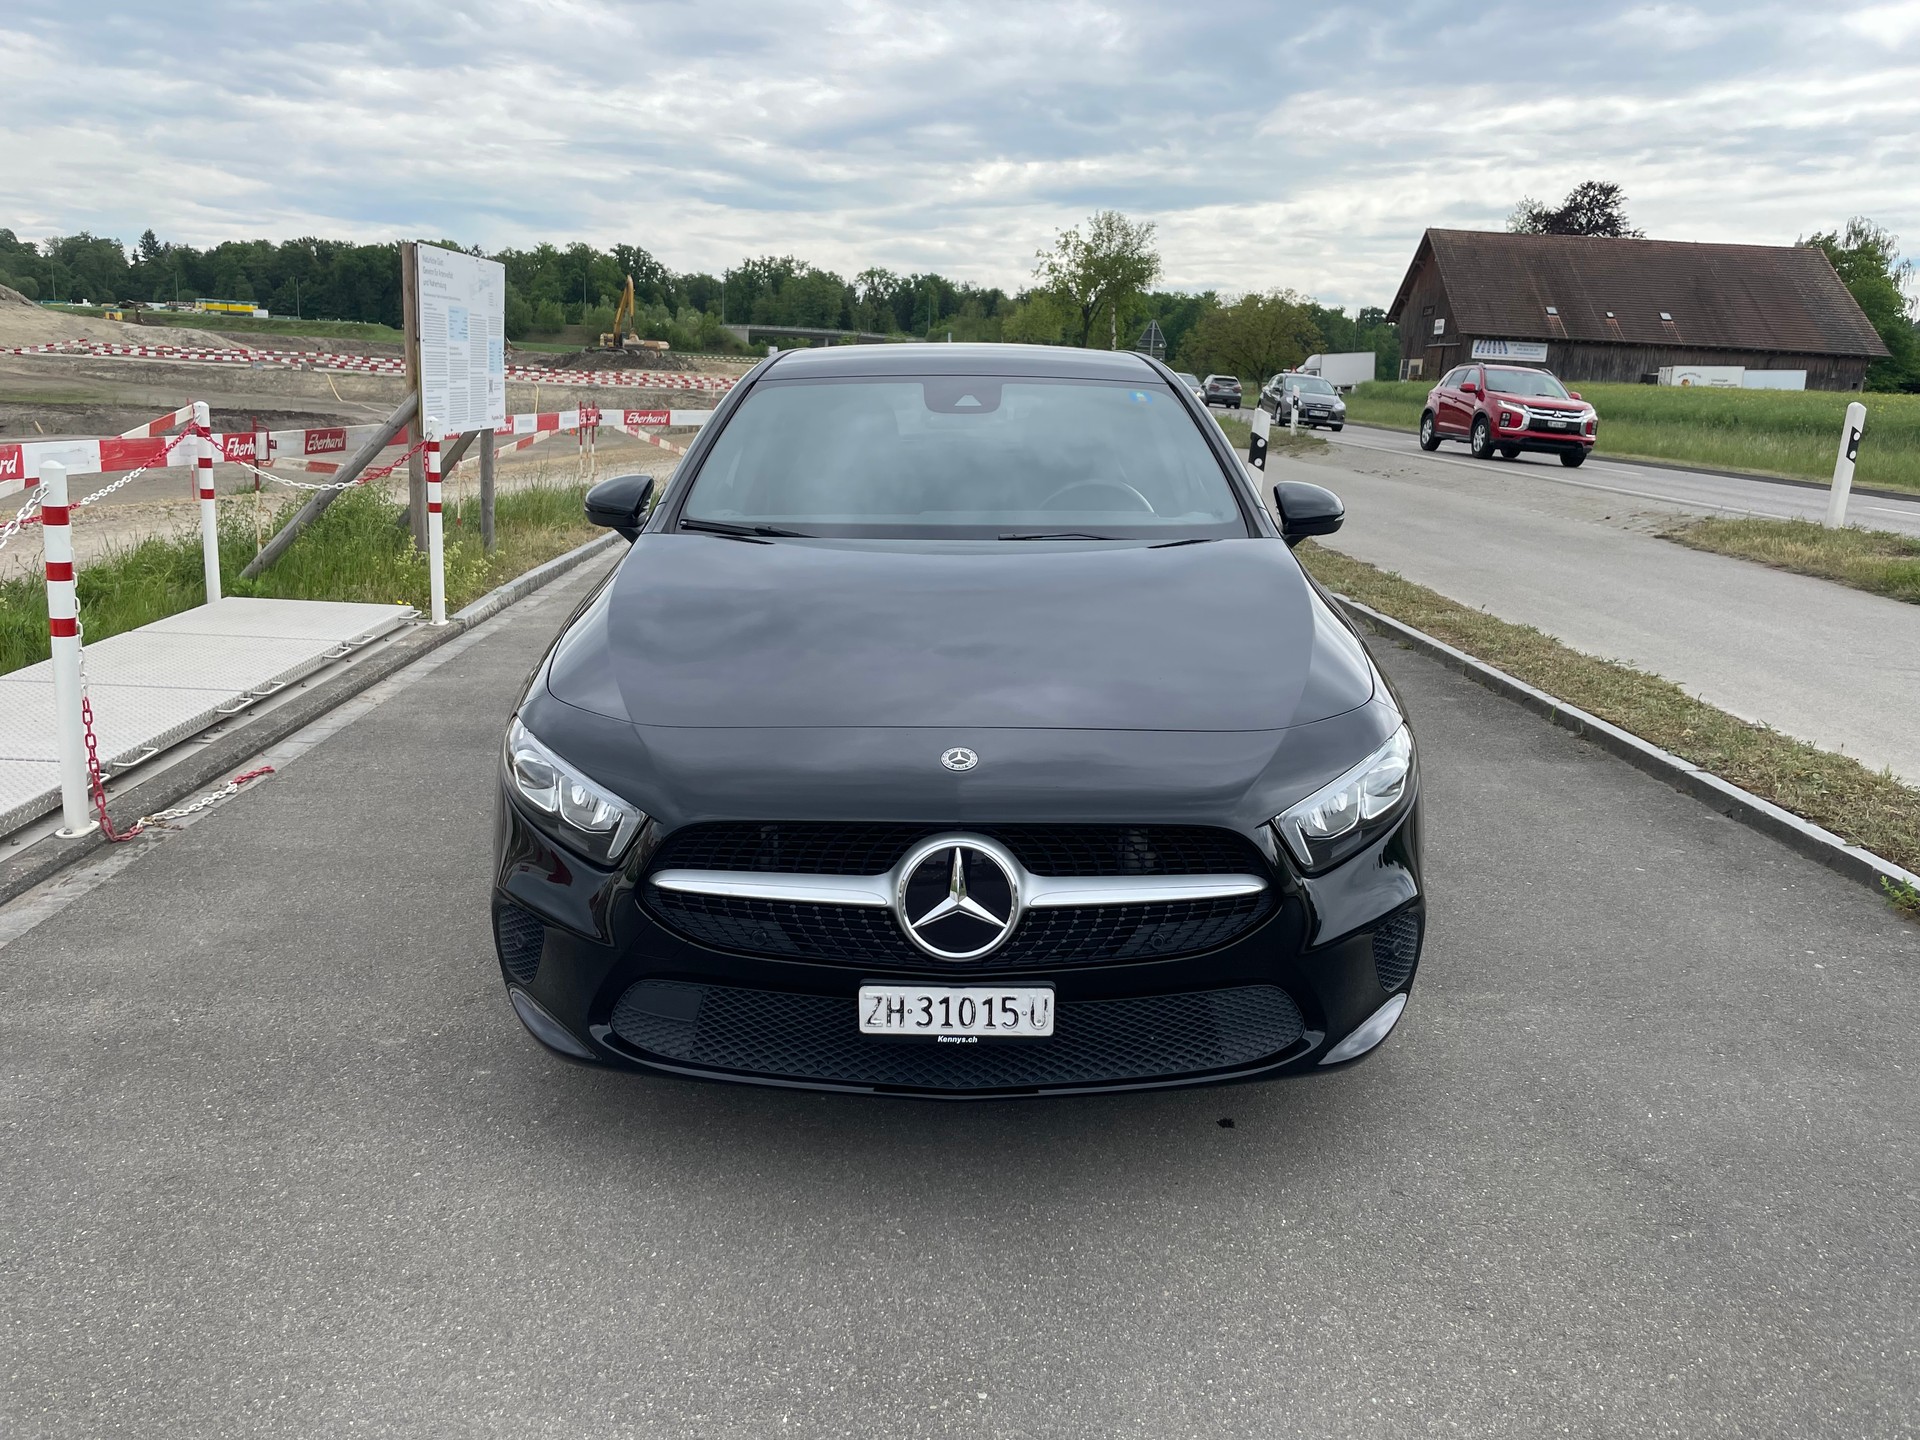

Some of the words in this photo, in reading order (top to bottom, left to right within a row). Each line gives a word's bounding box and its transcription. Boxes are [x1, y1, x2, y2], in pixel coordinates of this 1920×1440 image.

[627, 412, 668, 424] Eberhard
[308, 431, 345, 451] Eberhard
[937, 1035, 978, 1045] Kennys.ch
